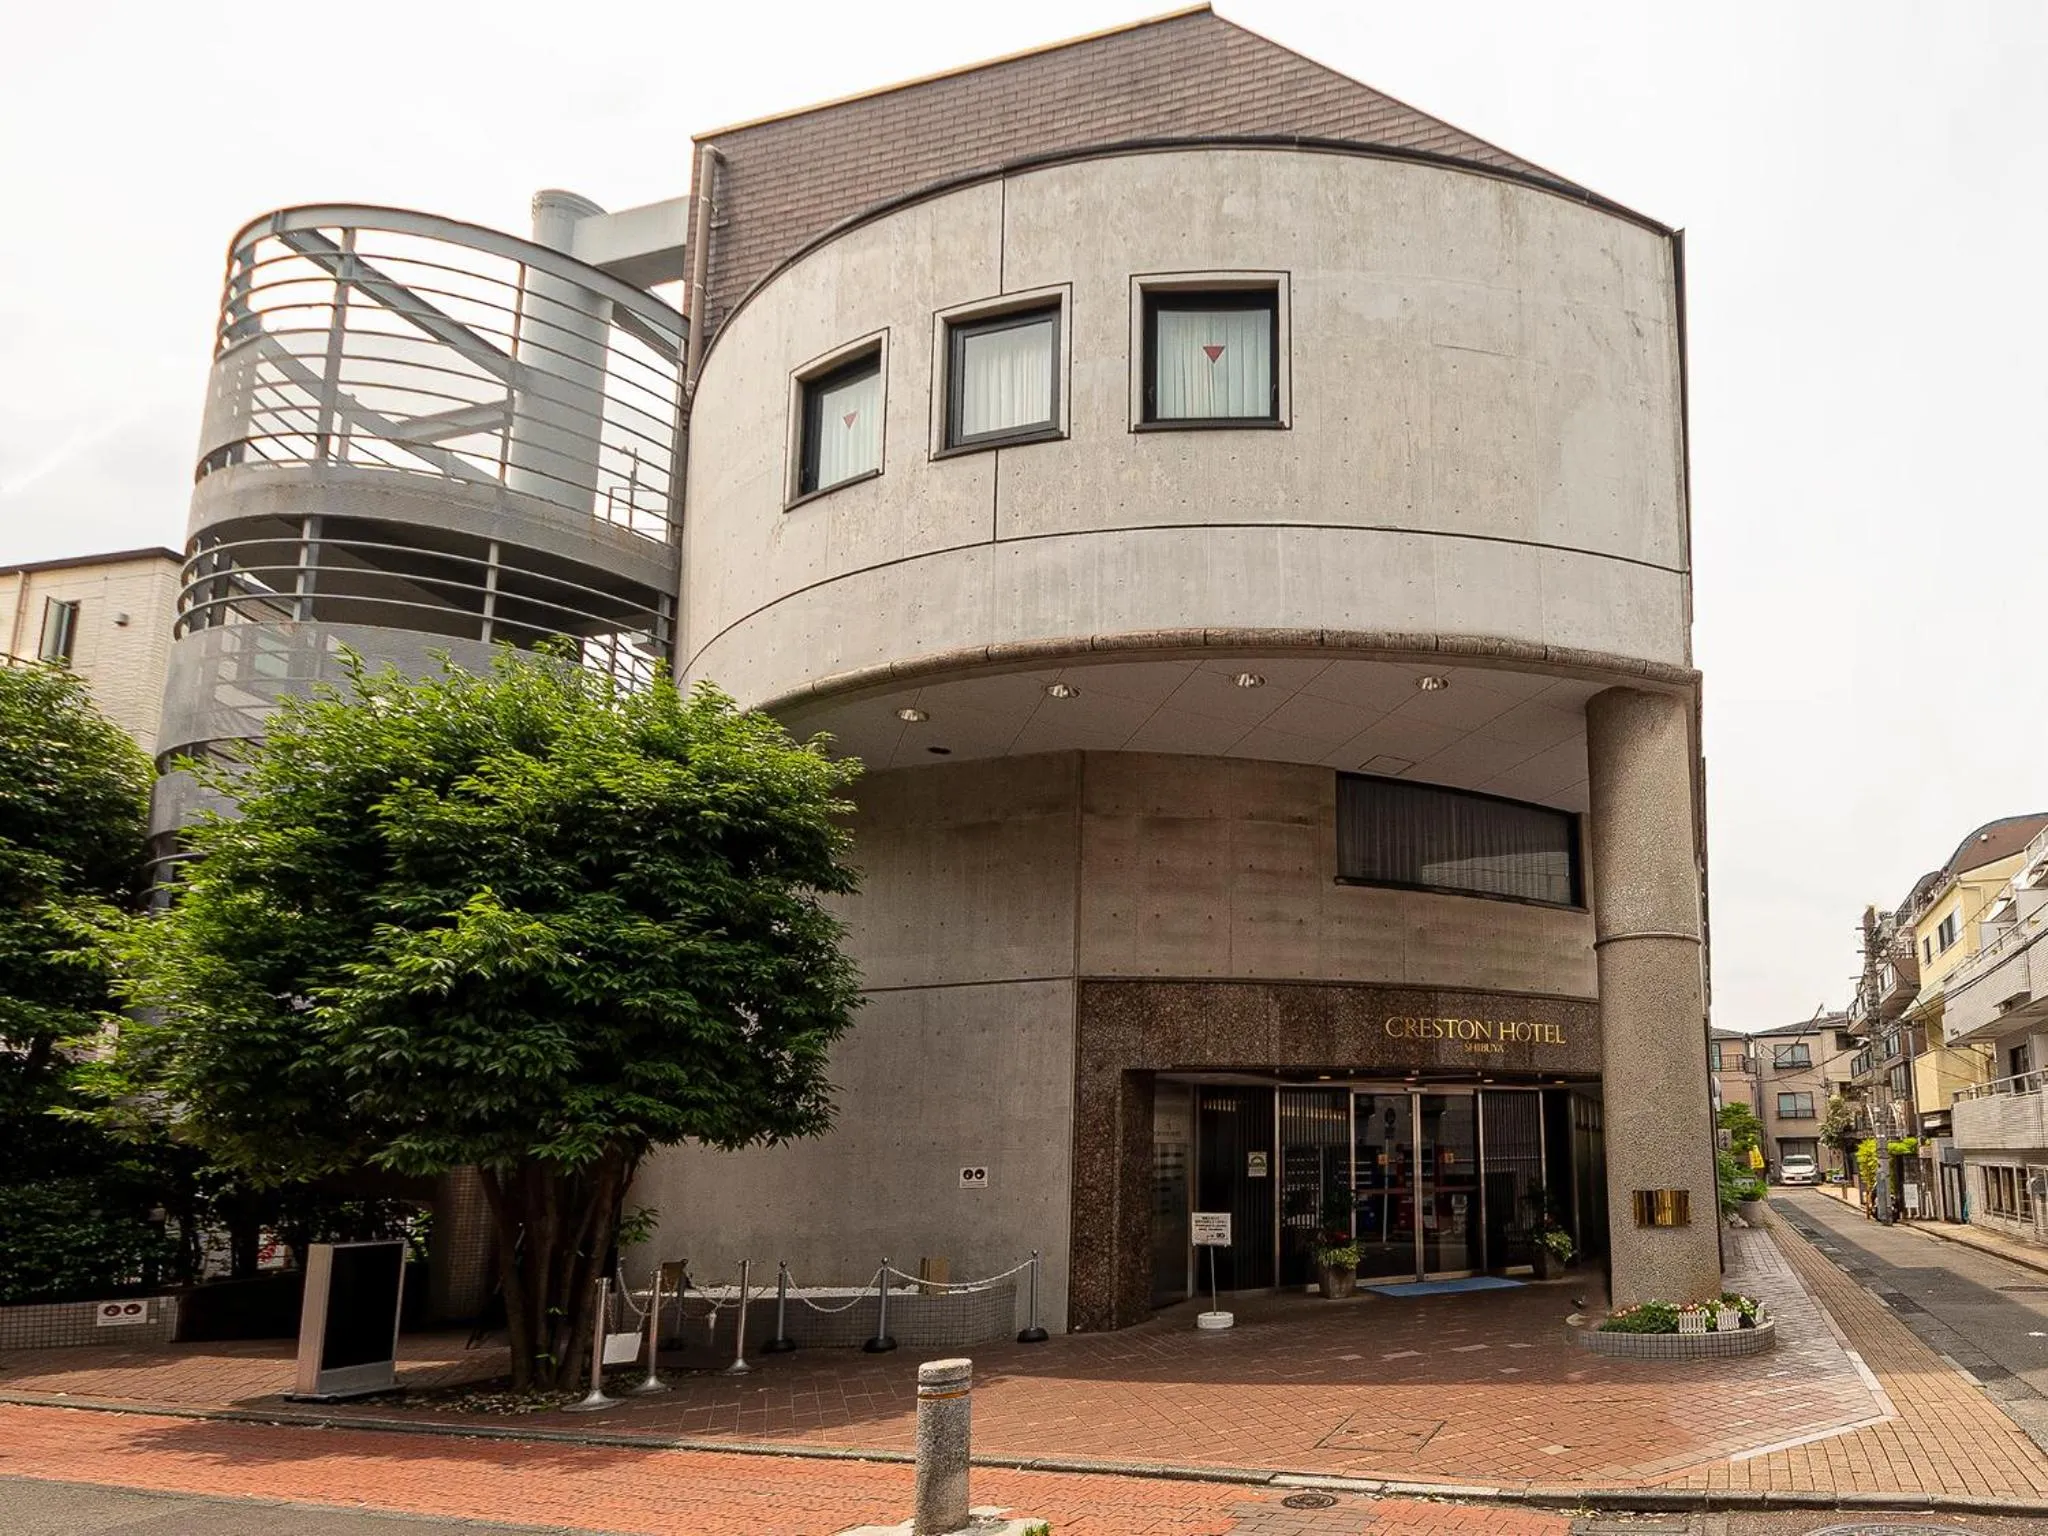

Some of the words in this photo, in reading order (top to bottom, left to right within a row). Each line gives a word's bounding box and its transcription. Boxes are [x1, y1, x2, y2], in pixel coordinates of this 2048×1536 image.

[1385, 1016, 1492, 1040] CRESTON
[1499, 1021, 1566, 1044] HOTEL
[1464, 1043, 1504, 1053] SHIBUYA
